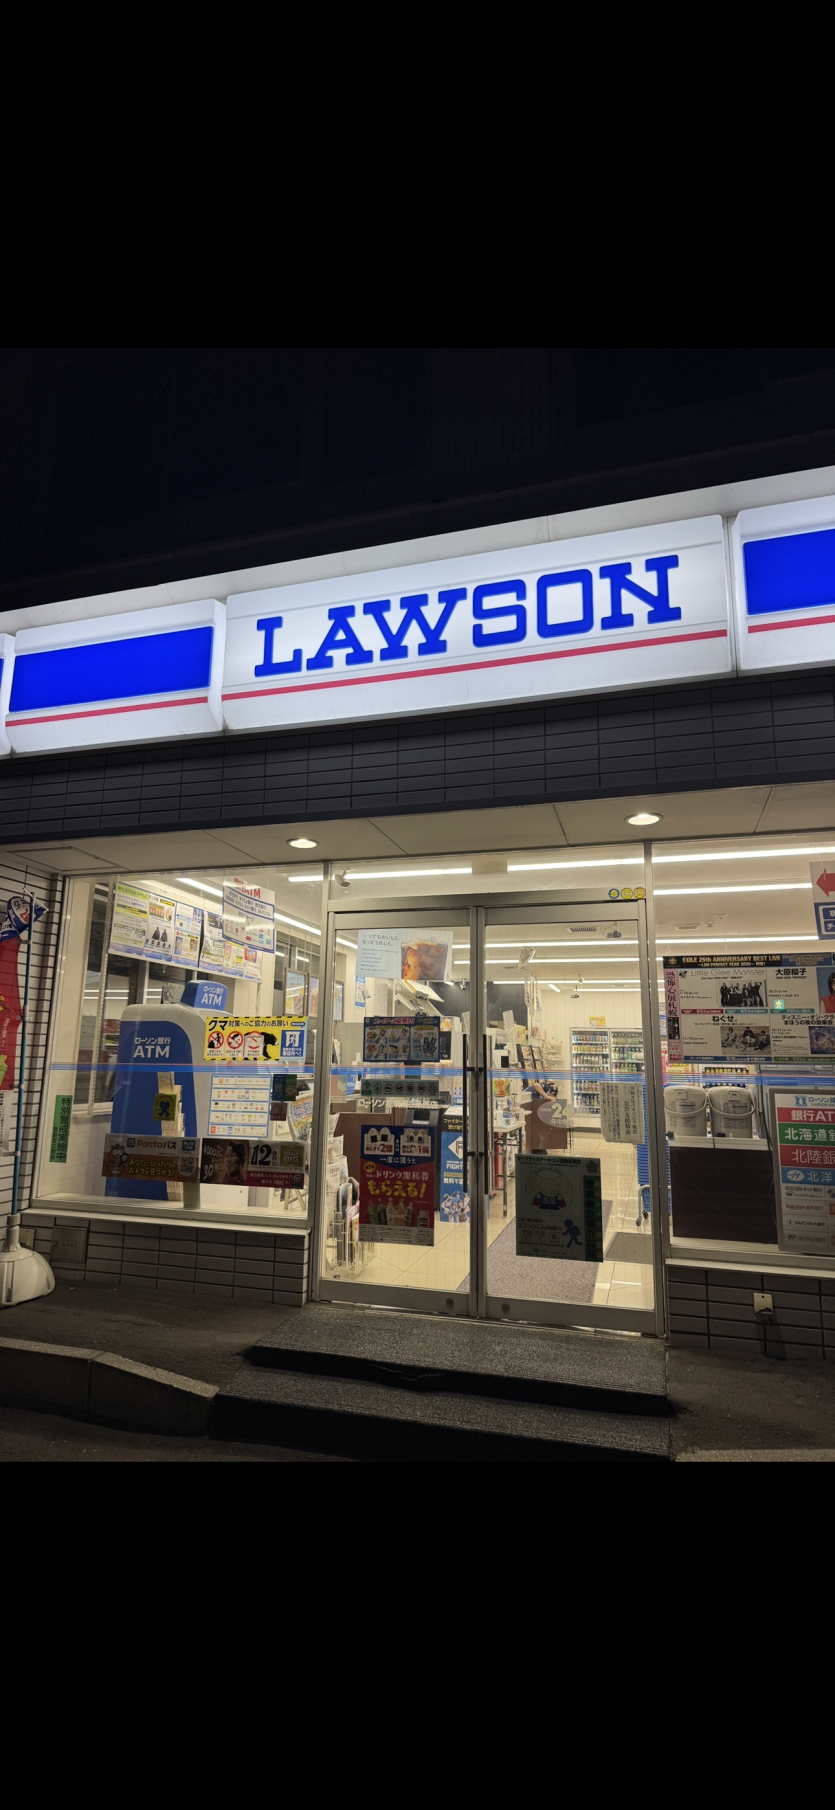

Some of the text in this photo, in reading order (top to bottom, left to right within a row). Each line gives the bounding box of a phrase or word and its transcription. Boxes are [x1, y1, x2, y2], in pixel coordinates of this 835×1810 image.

[254, 554, 681, 677] LAWSON
[362, 933, 401, 942] いつでもおいしく、
[362, 939, 393, 947] もっとうれしく。
[713, 955, 752, 963] ANNIVERSARY
[690, 968, 766, 977] Little Glee Monster
[203, 985, 224, 995] ローソン銀行
[666, 971, 678, 1017] 恐怖心展札幌
[201, 993, 222, 1007] ATM
[208, 1019, 289, 1032] クマ対策へのご協力のお願い
[134, 1036, 171, 1046] ローソン銀行
[133, 1045, 170, 1058] ATM
[551, 1102, 573, 1119] 24
[791, 1109, 834, 1122] 銀行AT
[56, 1097, 71, 1161] 特別警戒実施中
[136, 1139, 177, 1150] Pontaパス
[251, 1144, 272, 1166] 12
[283, 1155, 301, 1163] BIG
[380, 1156, 416, 1165] 一度に買うと
[516, 1156, 581, 1165] セーフティステーション活動実施店
[128, 1158, 177, 1169] あなたにぴったりの
[128, 1167, 176, 1178] おトクが見つかる!
[806, 1170, 833, 1183] 北洋
[367, 1180, 427, 1198] もらえる!
[794, 1219, 826, 1227] ジャパンネット銀行
